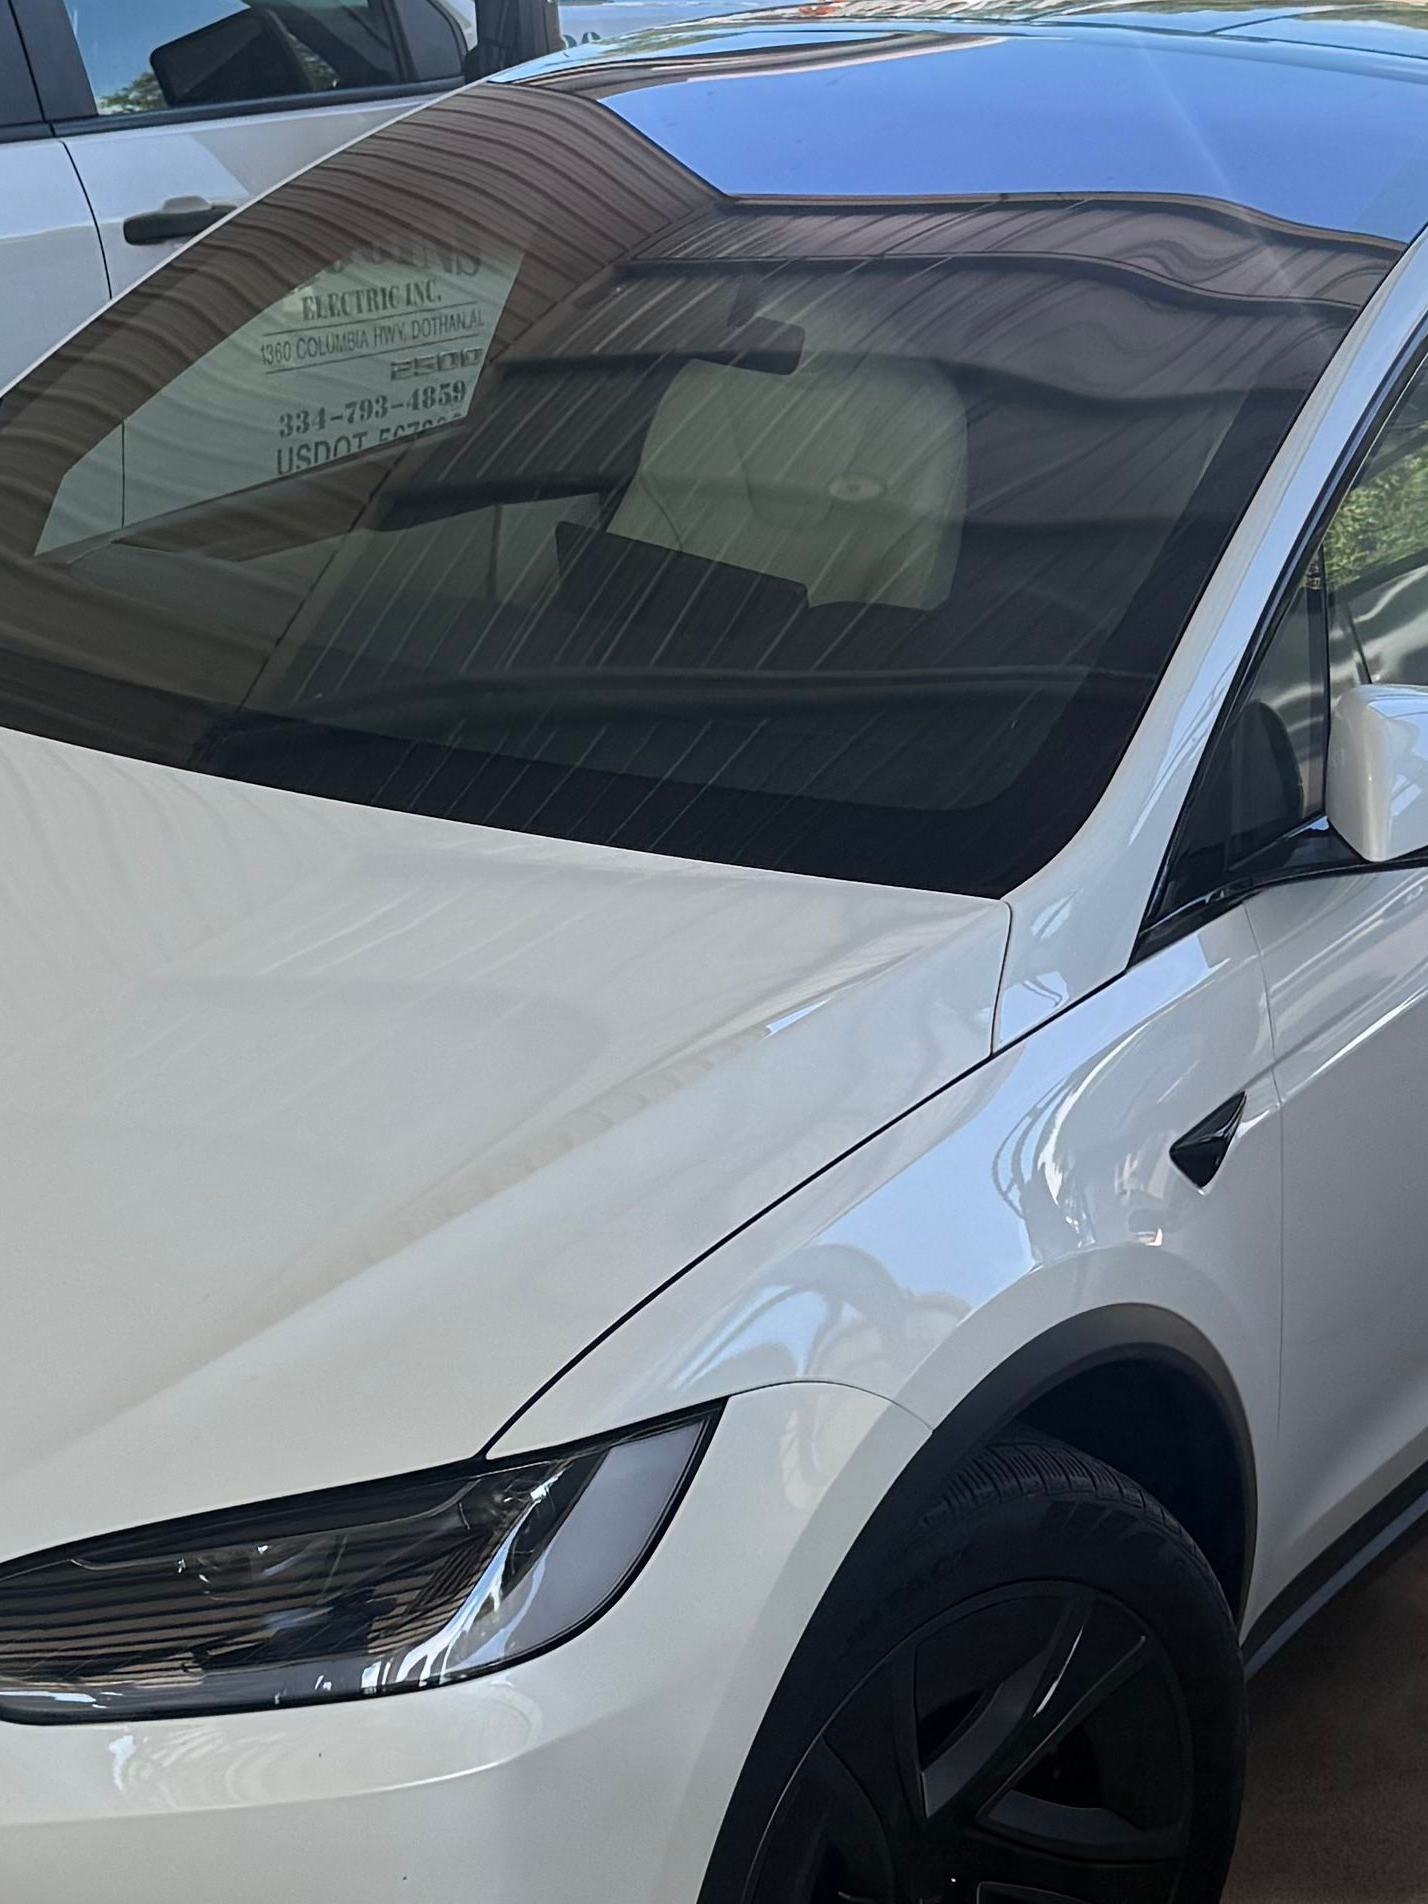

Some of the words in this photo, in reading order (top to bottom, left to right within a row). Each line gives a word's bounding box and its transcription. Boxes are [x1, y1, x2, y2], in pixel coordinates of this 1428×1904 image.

[302, 286, 400, 321] ELECTRIC
[405, 279, 441, 308] INC.
[260, 342, 291, 365] 1360
[297, 331, 369, 360] COLUMBIA
[390, 346, 483, 380] 2500
[279, 380, 466, 438] 334-793-4859
